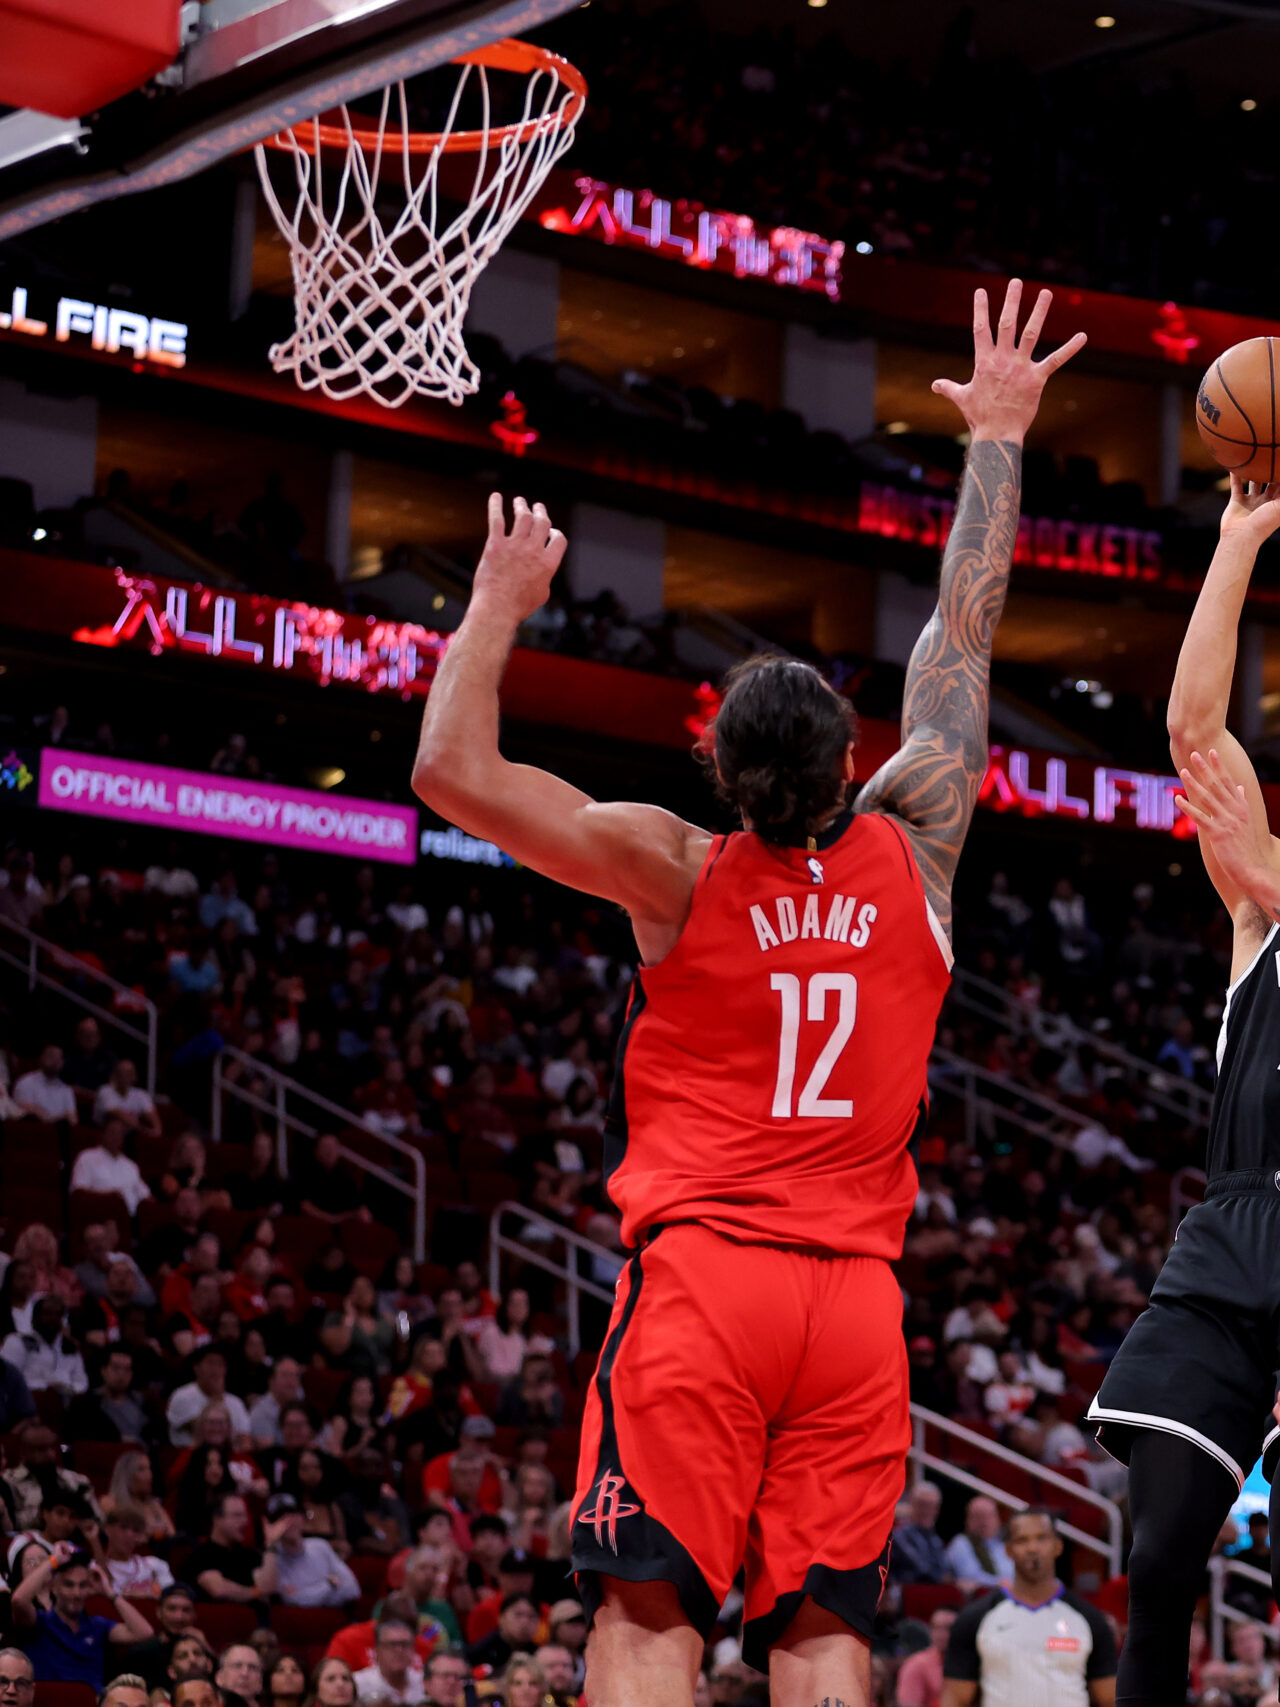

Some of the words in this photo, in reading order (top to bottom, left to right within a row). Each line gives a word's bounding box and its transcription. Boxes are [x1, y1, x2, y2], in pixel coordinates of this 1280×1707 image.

[55, 296, 189, 370] FIRE
[50, 764, 174, 814] OFFICIAL
[177, 784, 282, 830] ENERGY
[281, 801, 408, 849] PROVIDER
[749, 893, 878, 952] ADAMS
[770, 972, 858, 1118] 12
